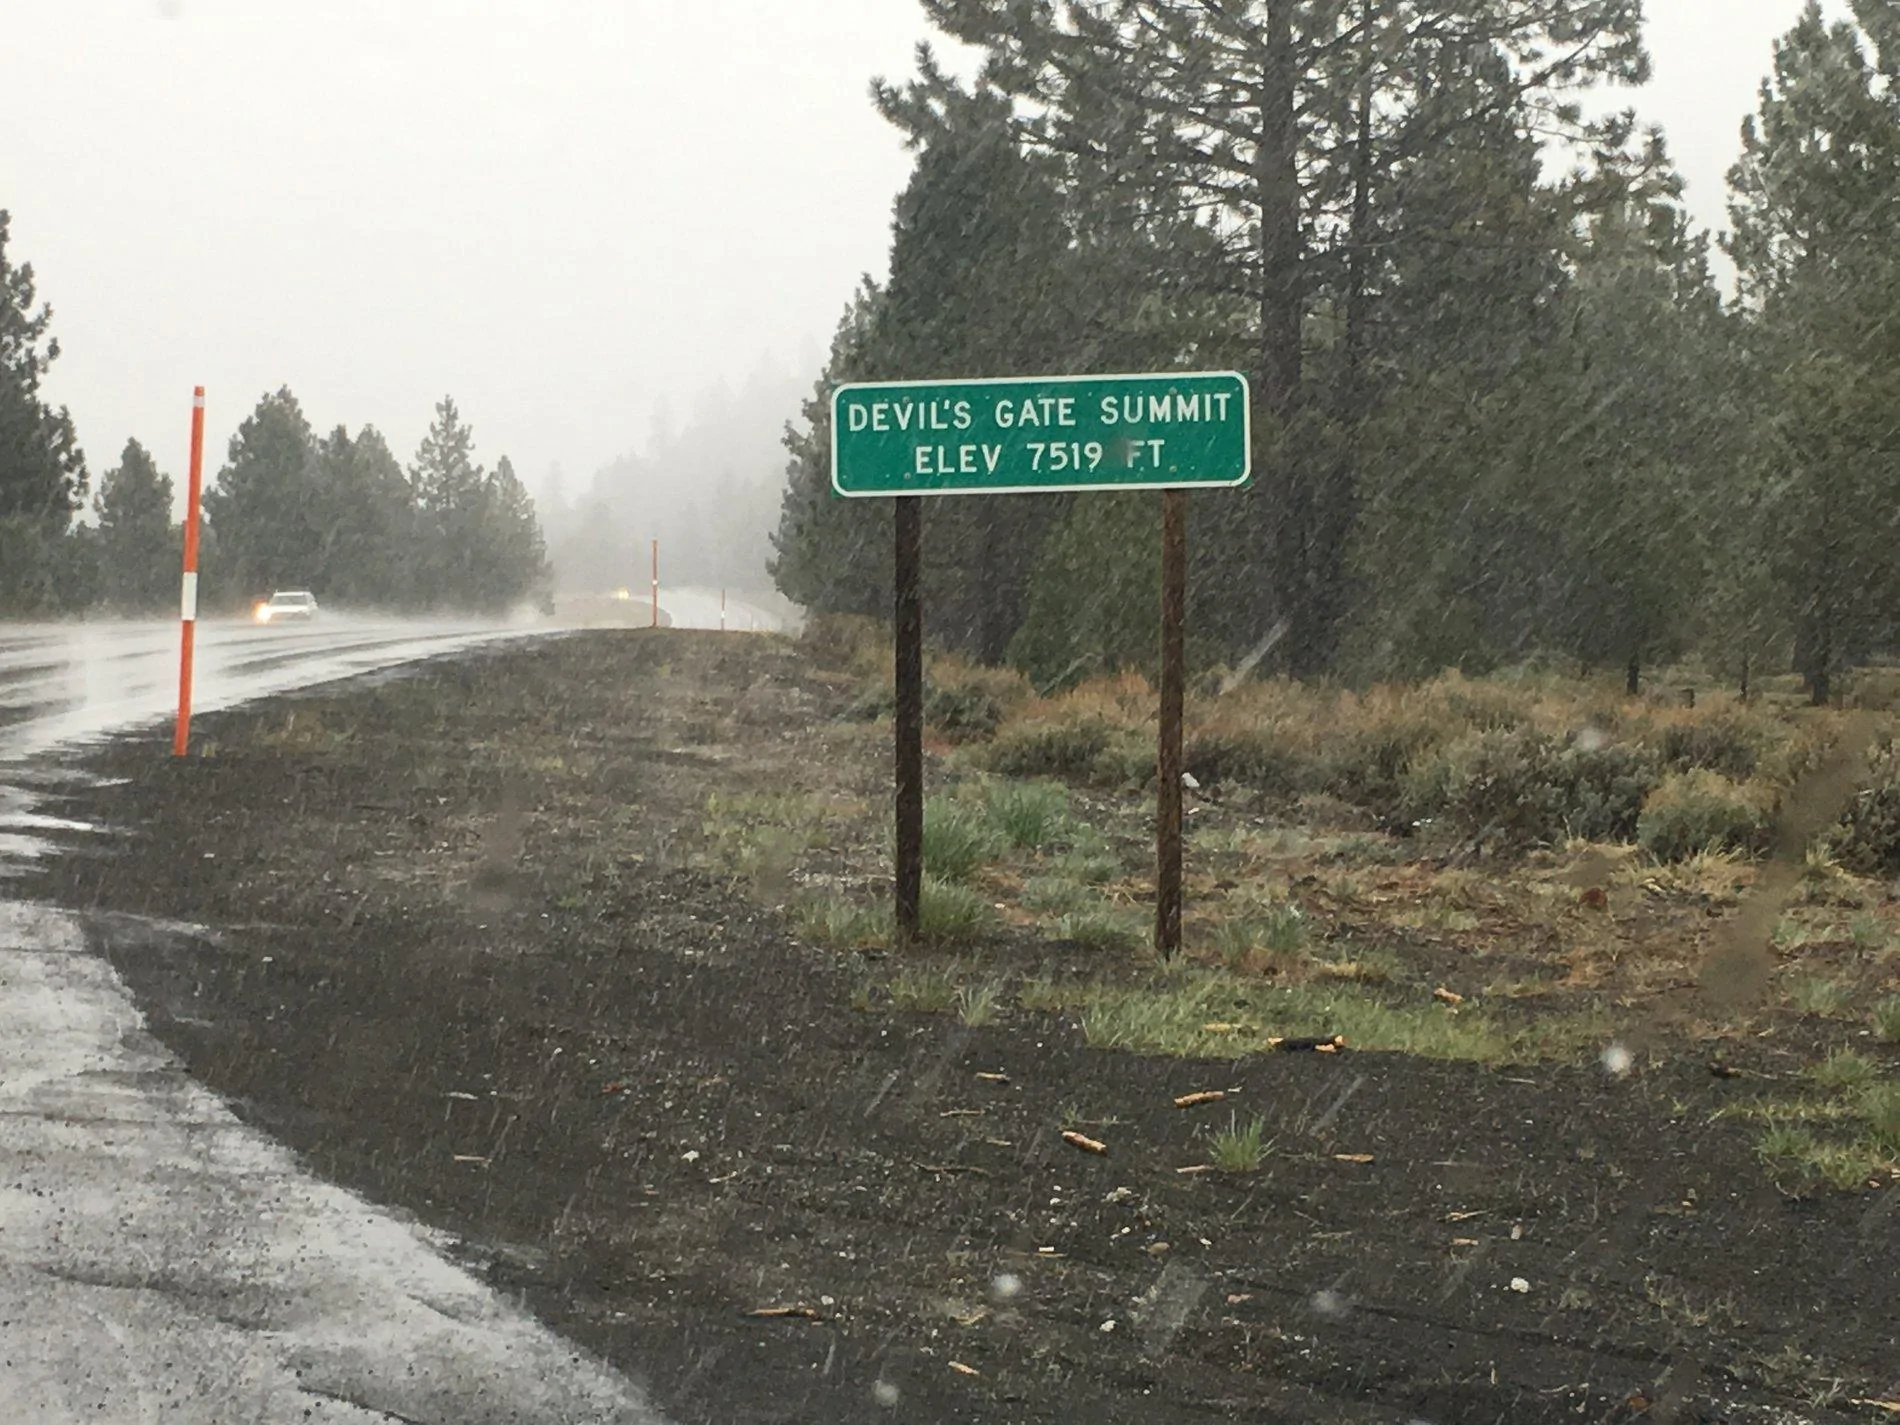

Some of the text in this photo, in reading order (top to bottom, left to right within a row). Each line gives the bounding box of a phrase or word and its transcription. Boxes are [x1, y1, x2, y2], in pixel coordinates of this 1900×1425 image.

[848, 393, 1232, 432] DEVIL'S GATE SUMMIT
[915, 439, 1165, 475] ELEV 7519 FT
